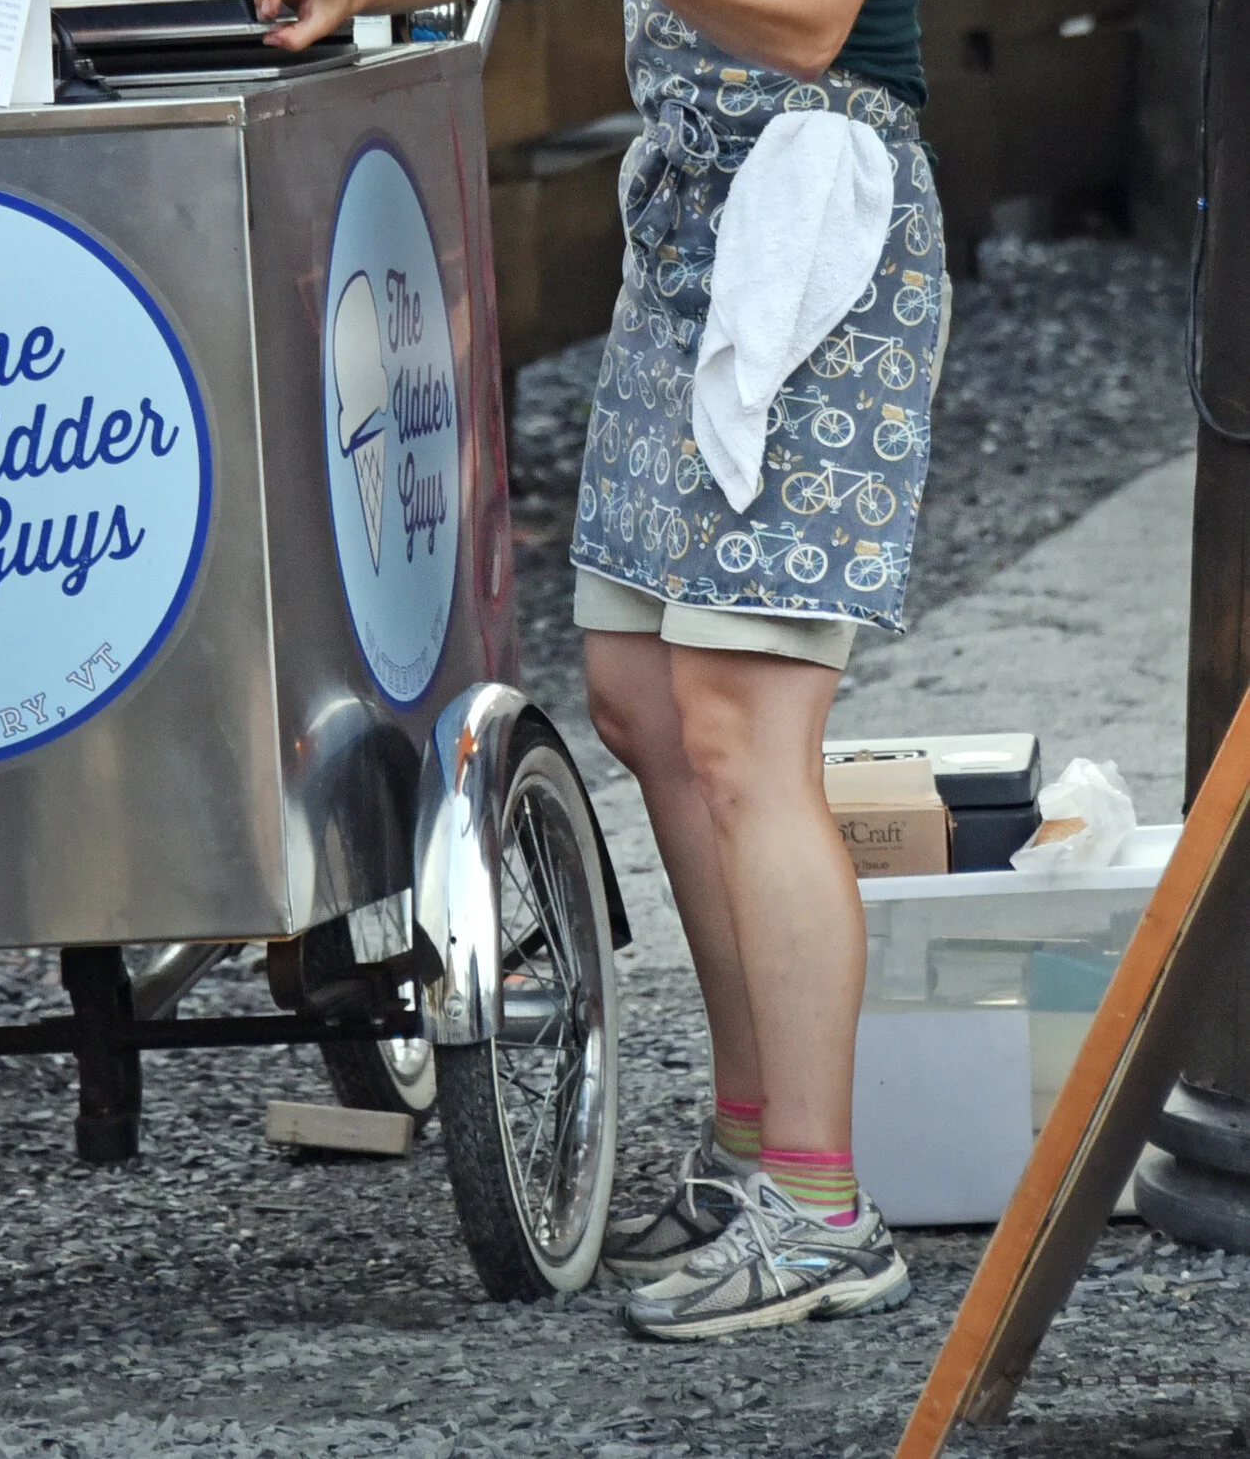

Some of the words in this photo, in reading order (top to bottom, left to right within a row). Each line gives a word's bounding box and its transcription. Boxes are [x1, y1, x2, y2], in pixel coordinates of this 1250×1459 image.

[386, 269, 425, 354] The
[393, 366, 452, 443] Udder
[397, 451, 446, 563] Guys
[66, 642, 123, 694] VT
